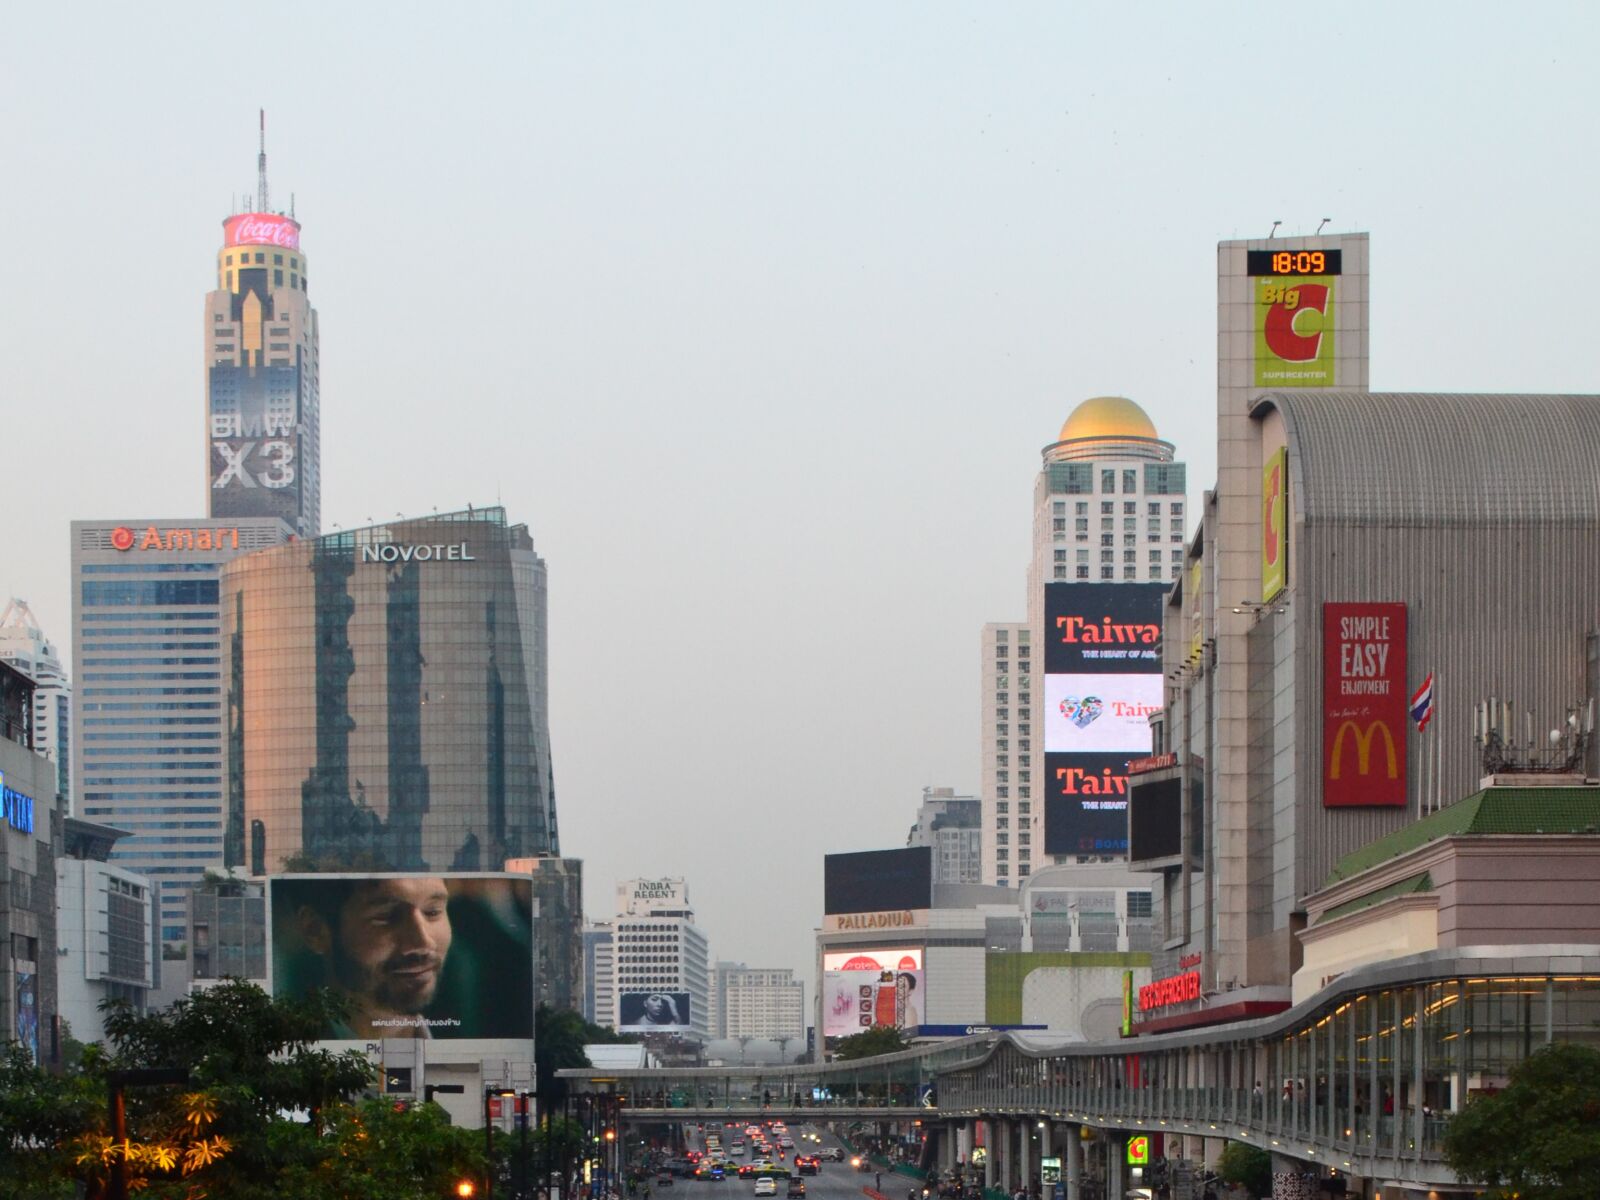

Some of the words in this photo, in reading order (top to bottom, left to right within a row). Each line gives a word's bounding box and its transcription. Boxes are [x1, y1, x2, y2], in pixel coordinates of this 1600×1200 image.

[1272, 252, 1324, 273] 18:09
[1261, 285, 1300, 310] Big
[1264, 283, 1331, 363] C
[211, 413, 297, 438] BMW
[212, 441, 294, 489] X3
[140, 524, 239, 550] Amari
[362, 542, 476, 561] NOVOTEL
[1341, 616, 1390, 640] SIMPLE
[1082, 650, 1099, 659] THE
[1341, 643, 1389, 678] EASY
[1341, 680, 1390, 695] ENJOYMENT
[1082, 801, 1099, 810] THE
[634, 890, 676, 899] REGENT
[639, 882, 671, 890] INDRA
[837, 911, 914, 929] PALLADIUM
